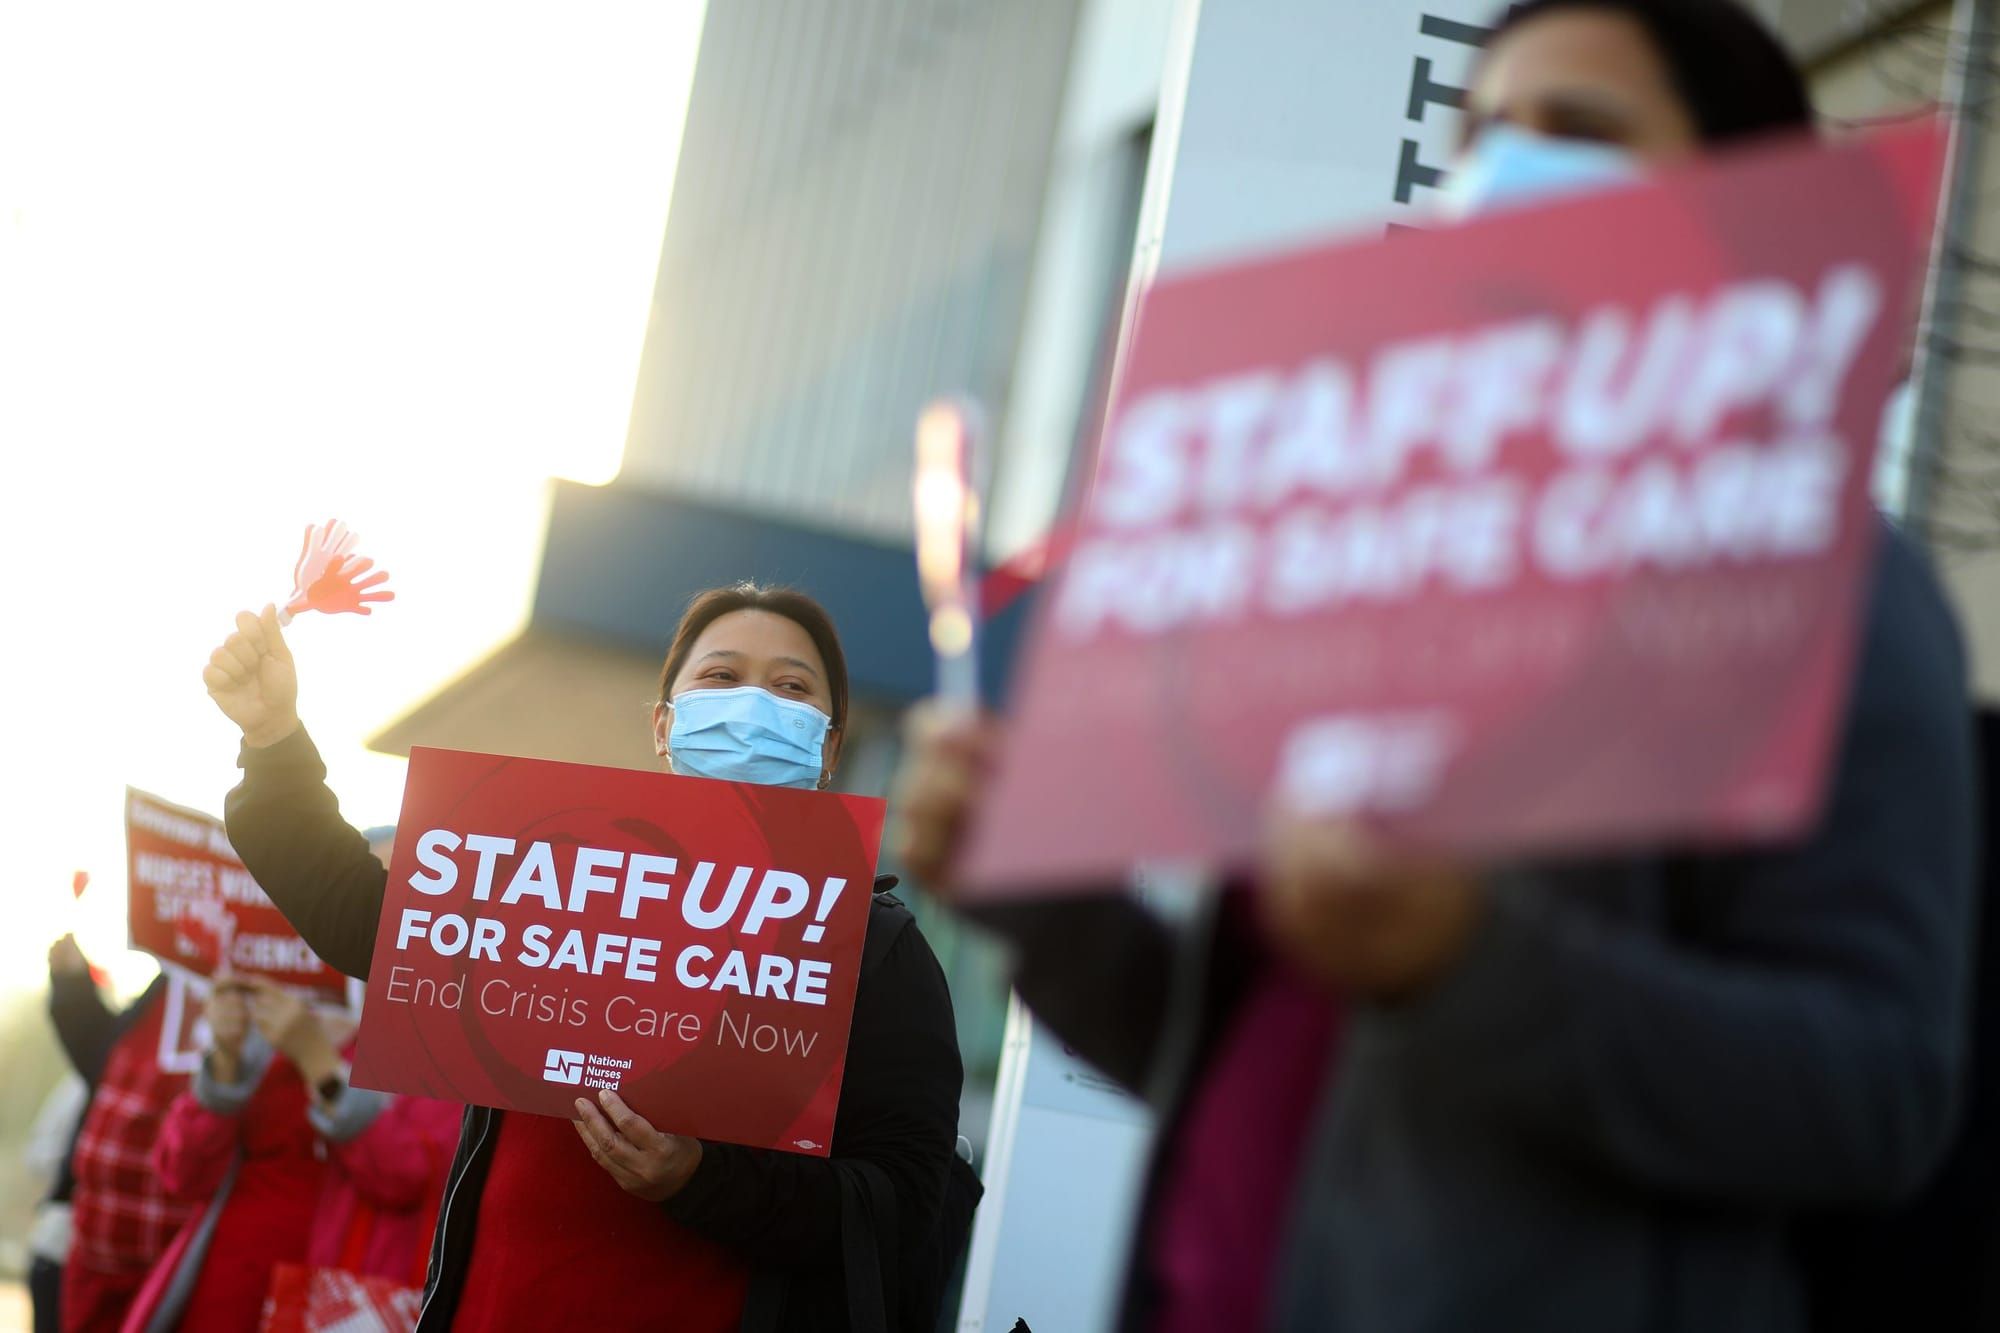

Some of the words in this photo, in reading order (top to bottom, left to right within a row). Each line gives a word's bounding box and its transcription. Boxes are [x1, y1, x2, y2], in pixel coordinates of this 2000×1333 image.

[407, 829, 678, 919] STAFF
[681, 861, 848, 943] UP!
[396, 908, 506, 962] FOR
[517, 924, 662, 982] SAFE
[675, 944, 832, 1006] CARE
[386, 966, 466, 1010] End
[480, 979, 588, 1026] Crisis
[605, 996, 701, 1042] Care
[717, 1010, 819, 1058] Now
[584, 1077, 619, 1091] United
[586, 1066, 622, 1080] Nurses
[588, 1054, 632, 1069] National
